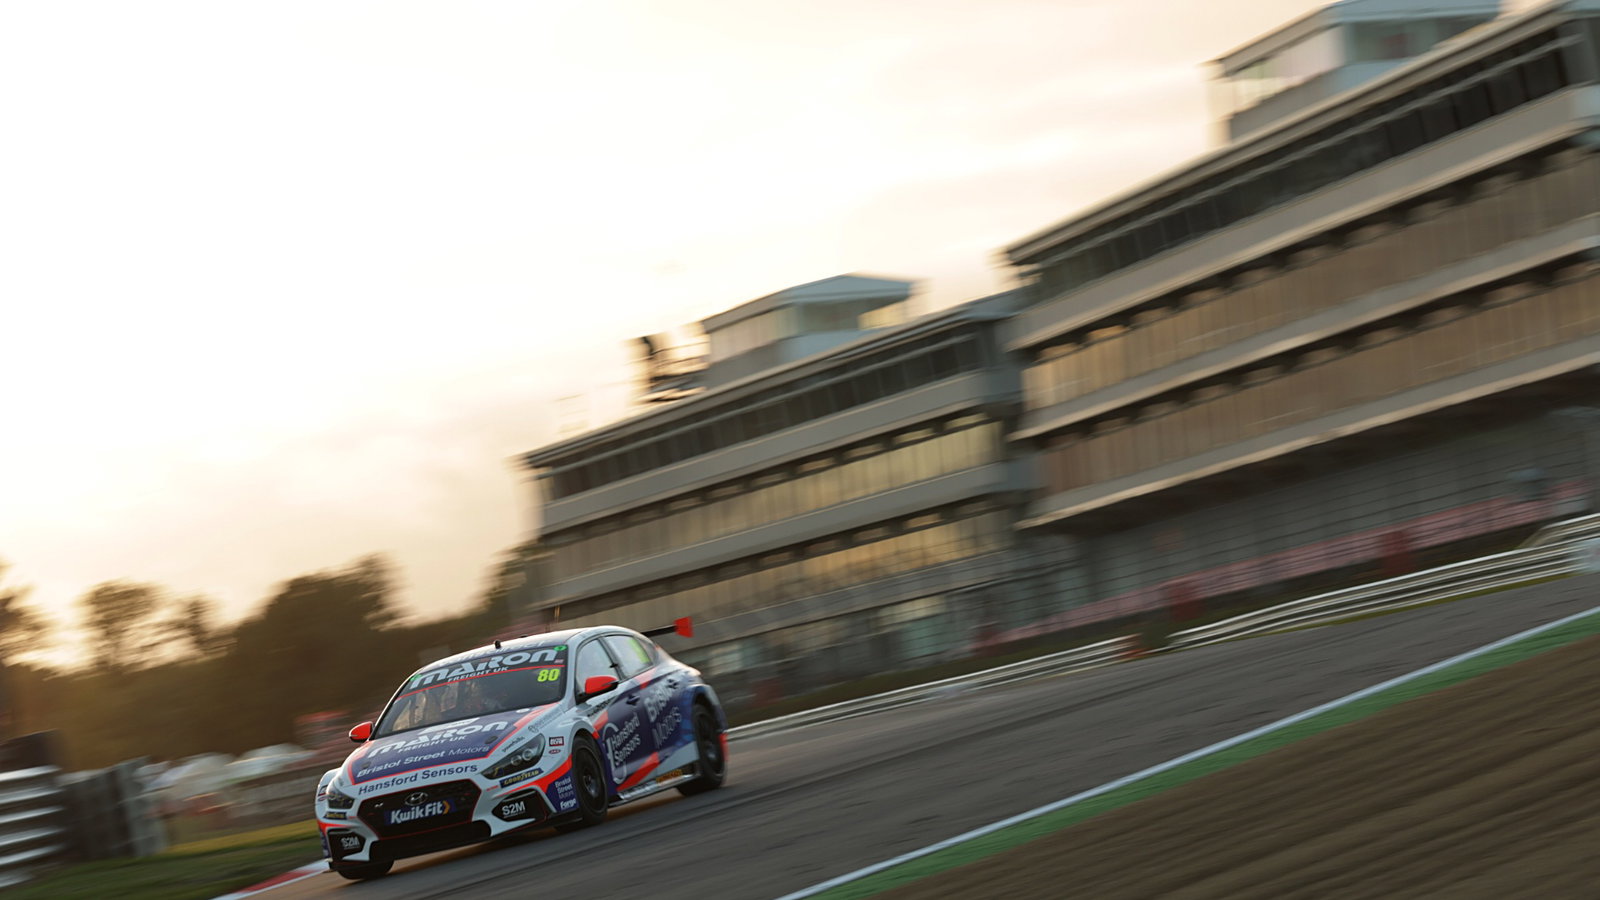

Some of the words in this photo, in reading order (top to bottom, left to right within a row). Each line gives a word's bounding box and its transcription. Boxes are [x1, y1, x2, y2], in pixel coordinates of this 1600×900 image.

[447, 668, 491, 682] FREIGHT
[493, 666, 509, 674] UK
[537, 668, 560, 682] 80
[448, 735, 467, 743] UK
[357, 759, 401, 778] Bristol
[404, 751, 445, 765] Street
[448, 745, 490, 756] Motors
[358, 773, 418, 795] Hansford
[421, 764, 478, 780] Sensors
[503, 770, 540, 785] GOODYEAR
[502, 800, 526, 816] S2M
